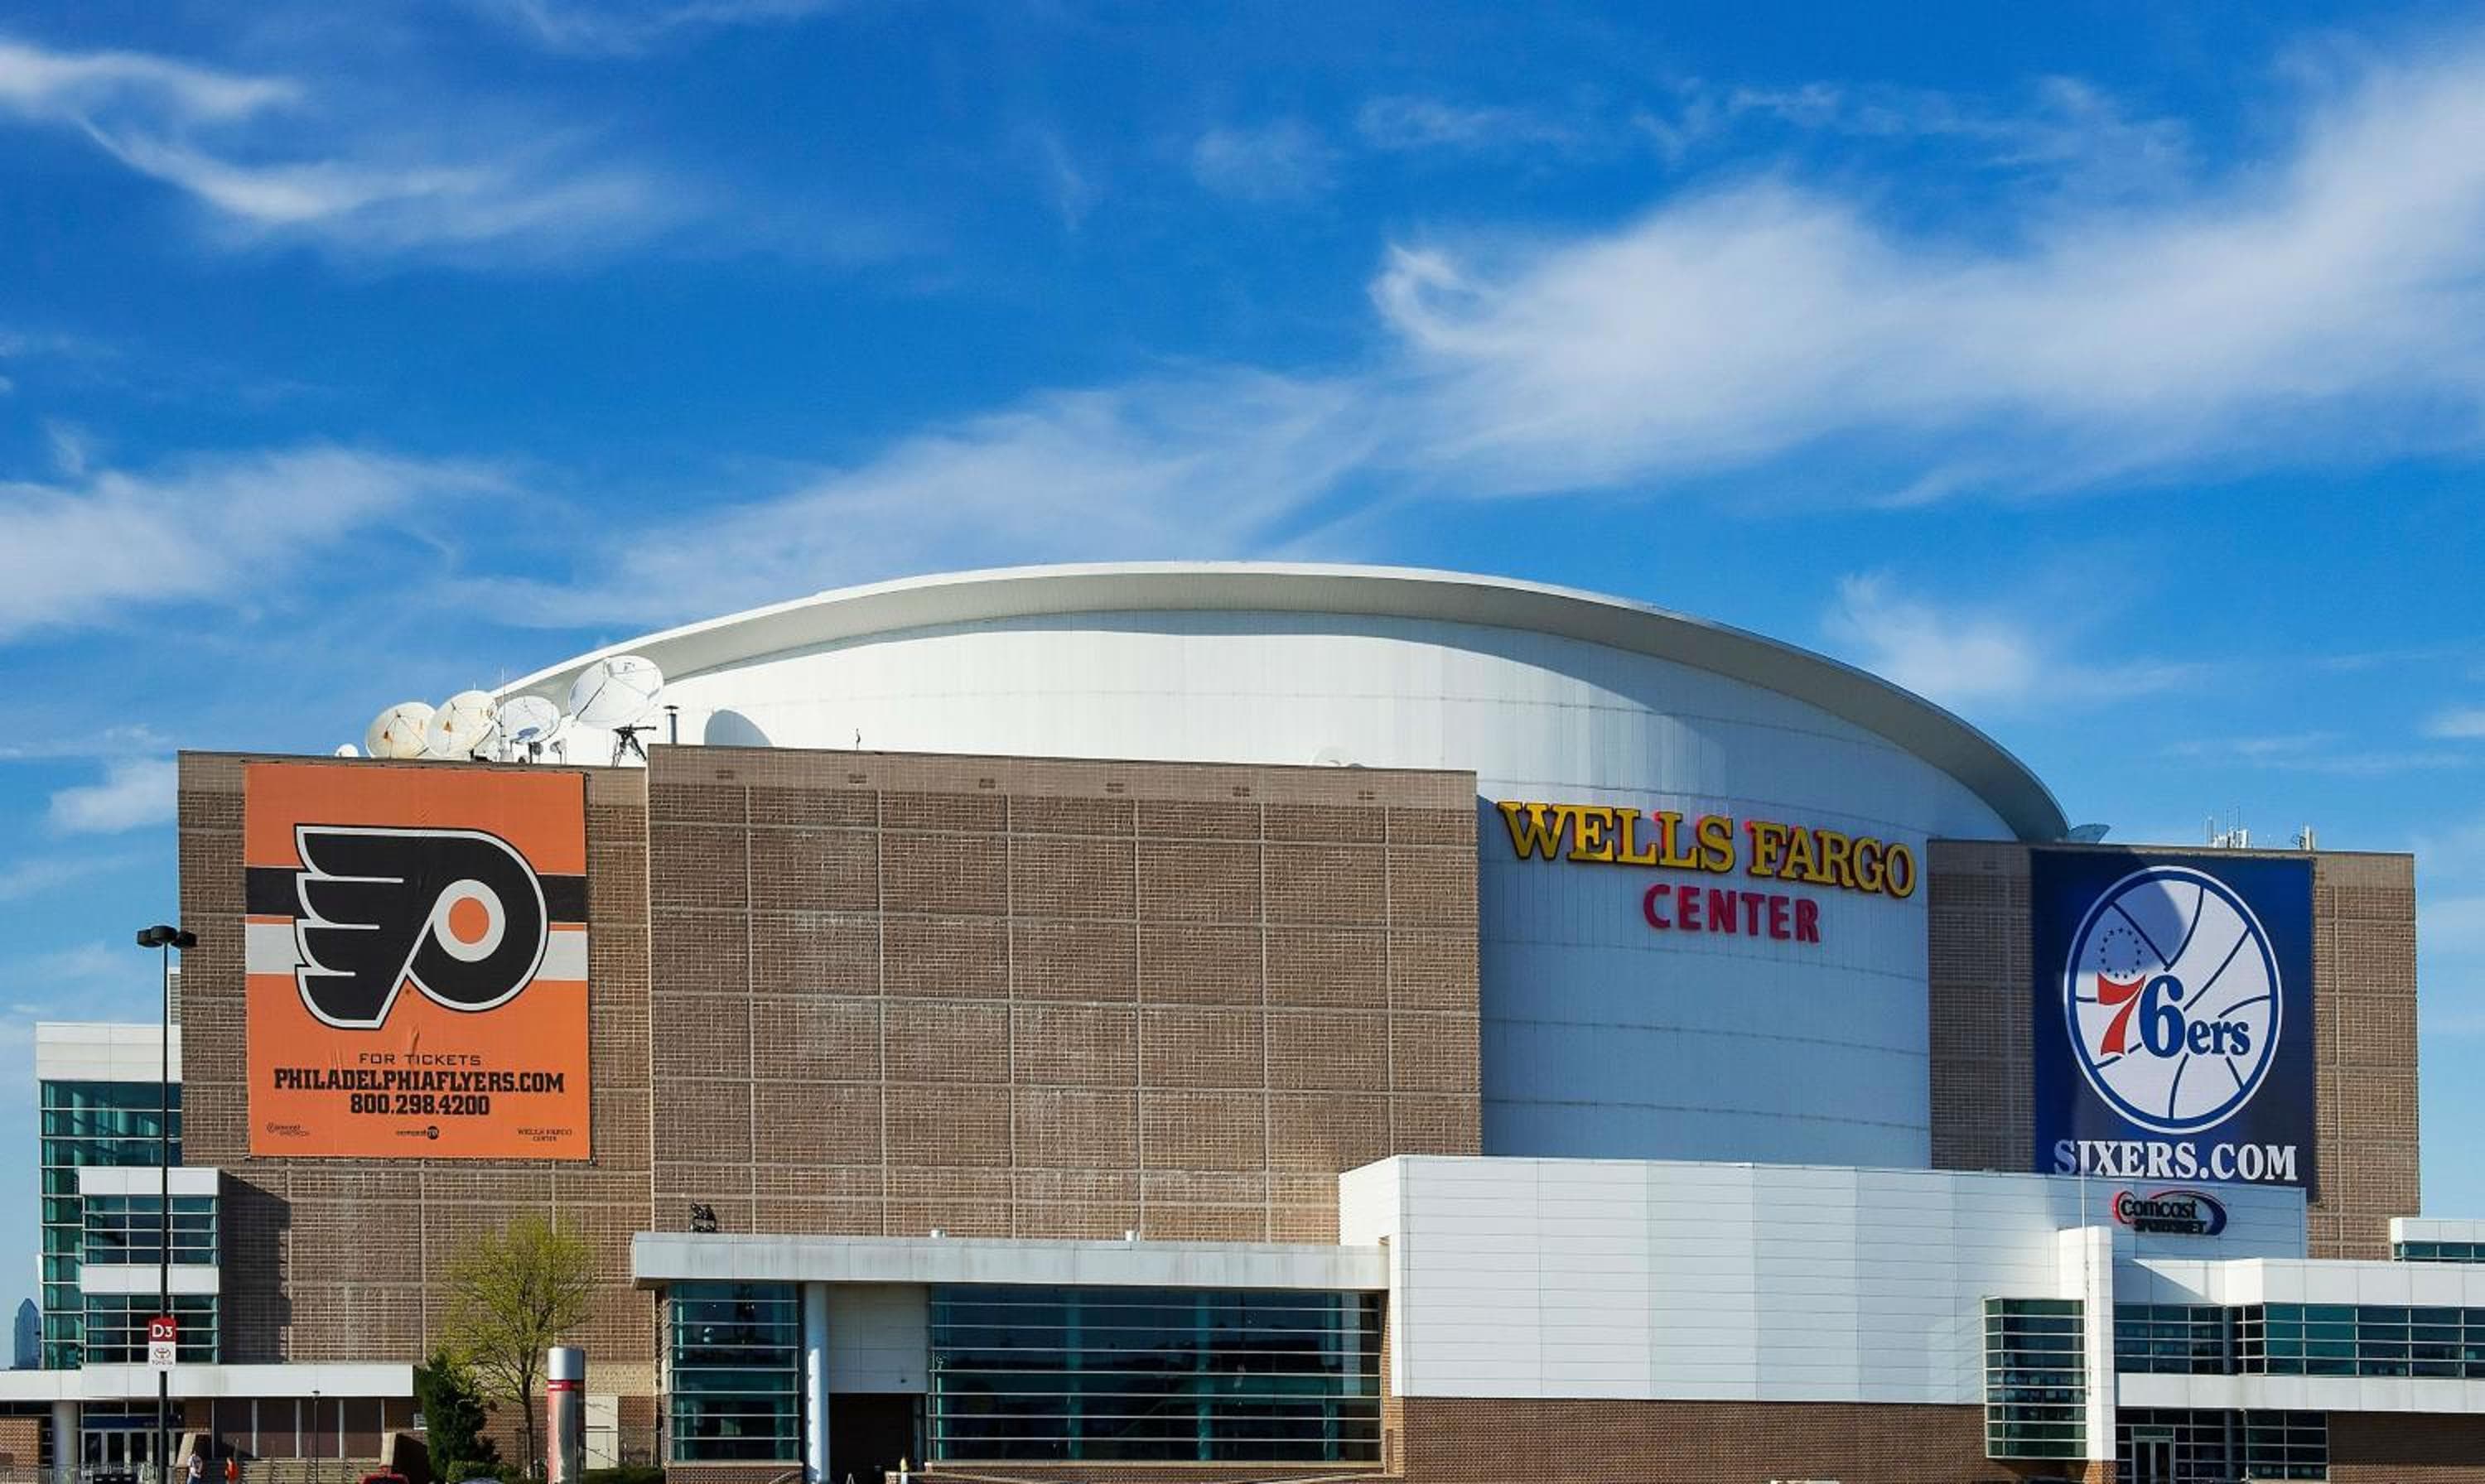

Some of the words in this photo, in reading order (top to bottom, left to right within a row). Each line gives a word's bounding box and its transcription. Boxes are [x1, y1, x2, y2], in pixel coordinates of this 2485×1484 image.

[1498, 801, 1736, 874] WELLS
[1745, 820, 1917, 899] FARGO
[1643, 883, 1820, 944] CENTER
[2097, 972, 2251, 1059] 76ers
[359, 1053, 395, 1065] FOR
[404, 1053, 481, 1067] TICKETS
[273, 1067, 564, 1093] PHILADELPHIAFLYERS.COM
[350, 1093, 490, 1116] 800.298.4200
[2053, 1139, 2298, 1182] SIXERS.COM
[152, 1324, 173, 1337] D3
